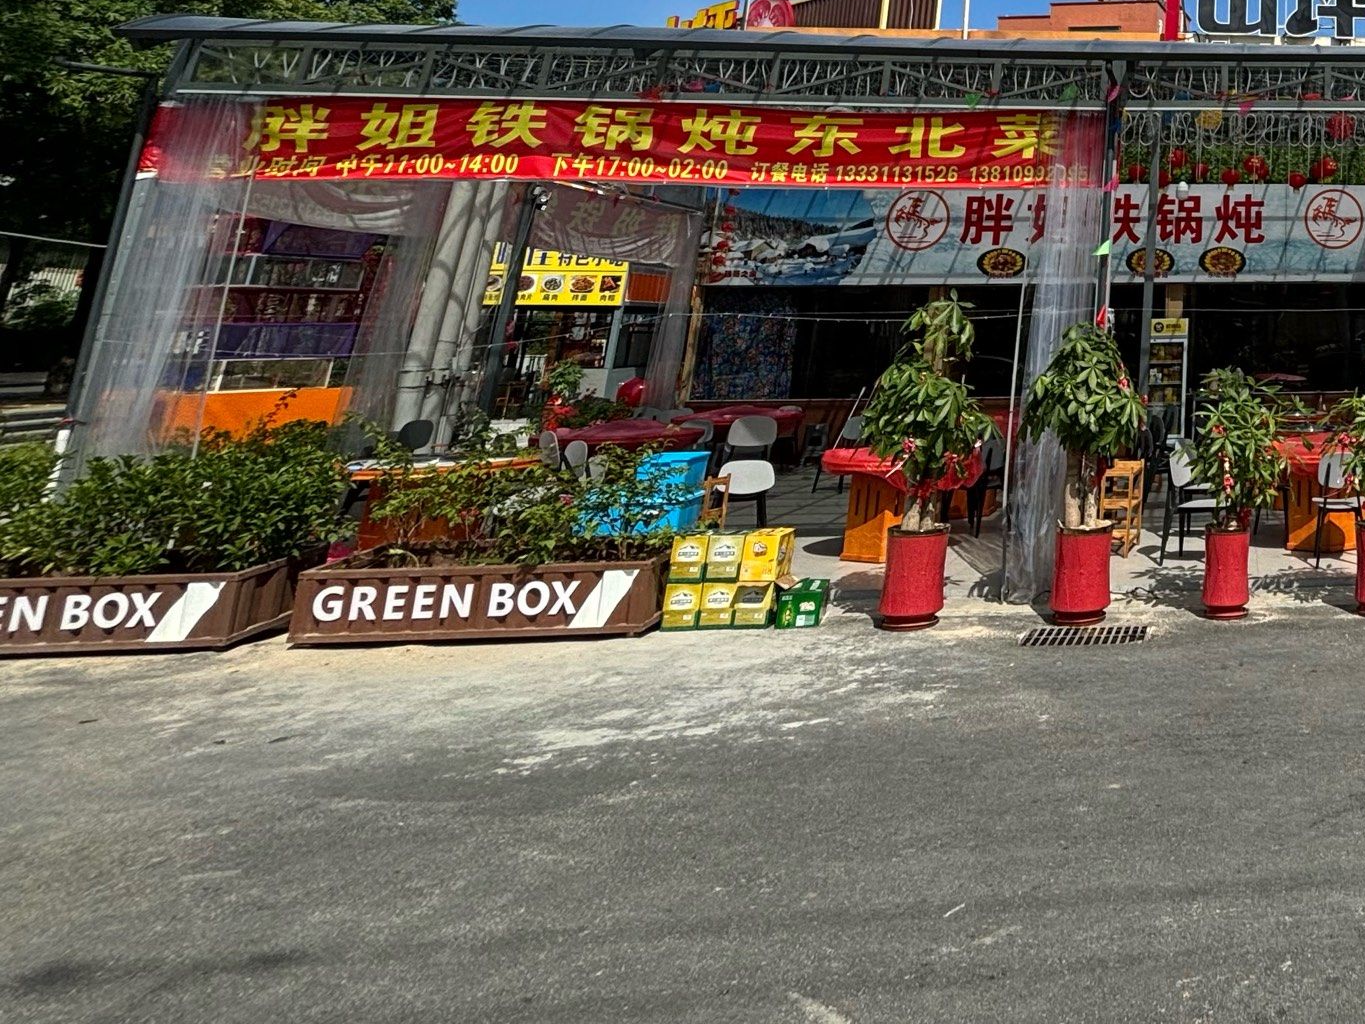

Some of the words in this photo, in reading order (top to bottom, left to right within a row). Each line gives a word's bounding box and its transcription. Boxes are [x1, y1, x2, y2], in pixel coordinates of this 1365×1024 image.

[242, 100, 1064, 160] 胖姐铁锅炖东北菜
[750, 161, 830, 183] 订餐电话
[834, 164, 959, 183] 13331131526
[60, 592, 163, 629] BOX
[312, 584, 475, 622] GREEN
[487, 580, 583, 618] BOX
